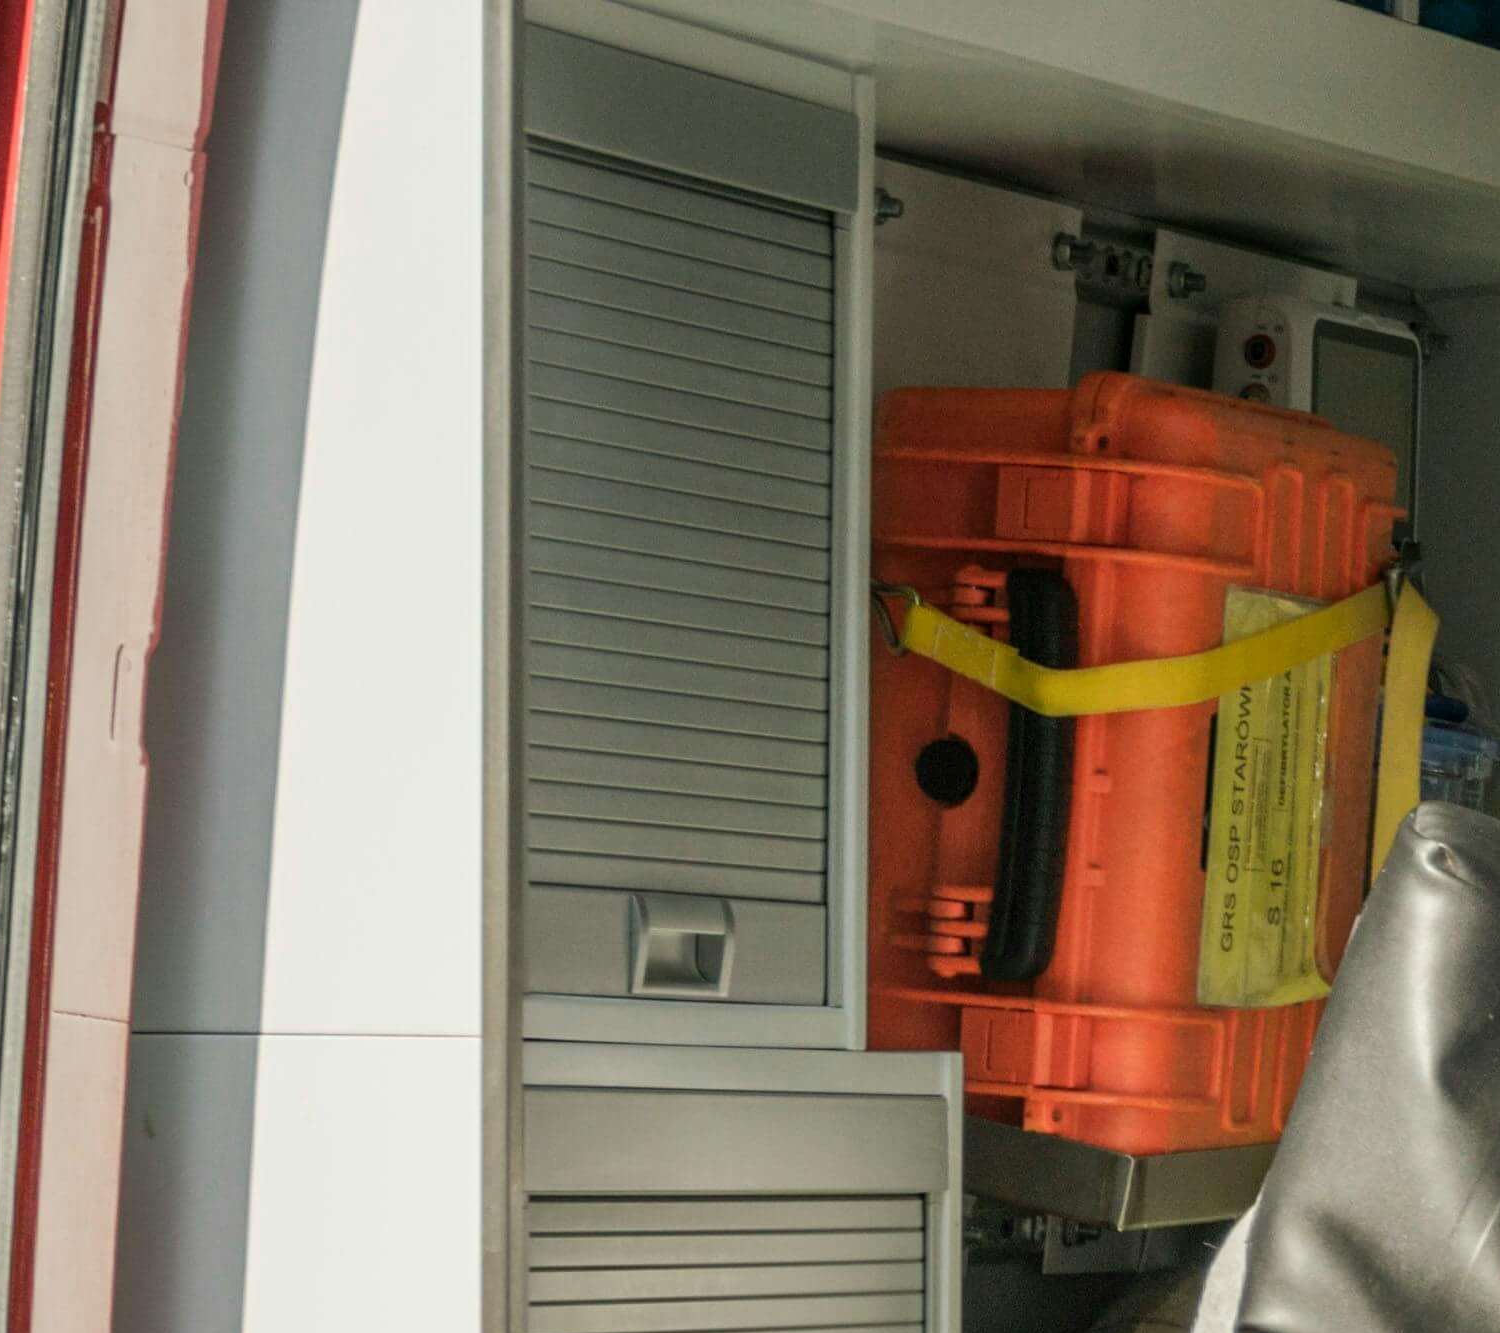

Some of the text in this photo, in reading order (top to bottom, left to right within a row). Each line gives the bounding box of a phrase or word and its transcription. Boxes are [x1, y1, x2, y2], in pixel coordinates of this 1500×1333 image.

[1226, 826, 1241, 883] OSP
[1220, 893, 1237, 953] GRS
[1267, 860, 1285, 926] S 16
